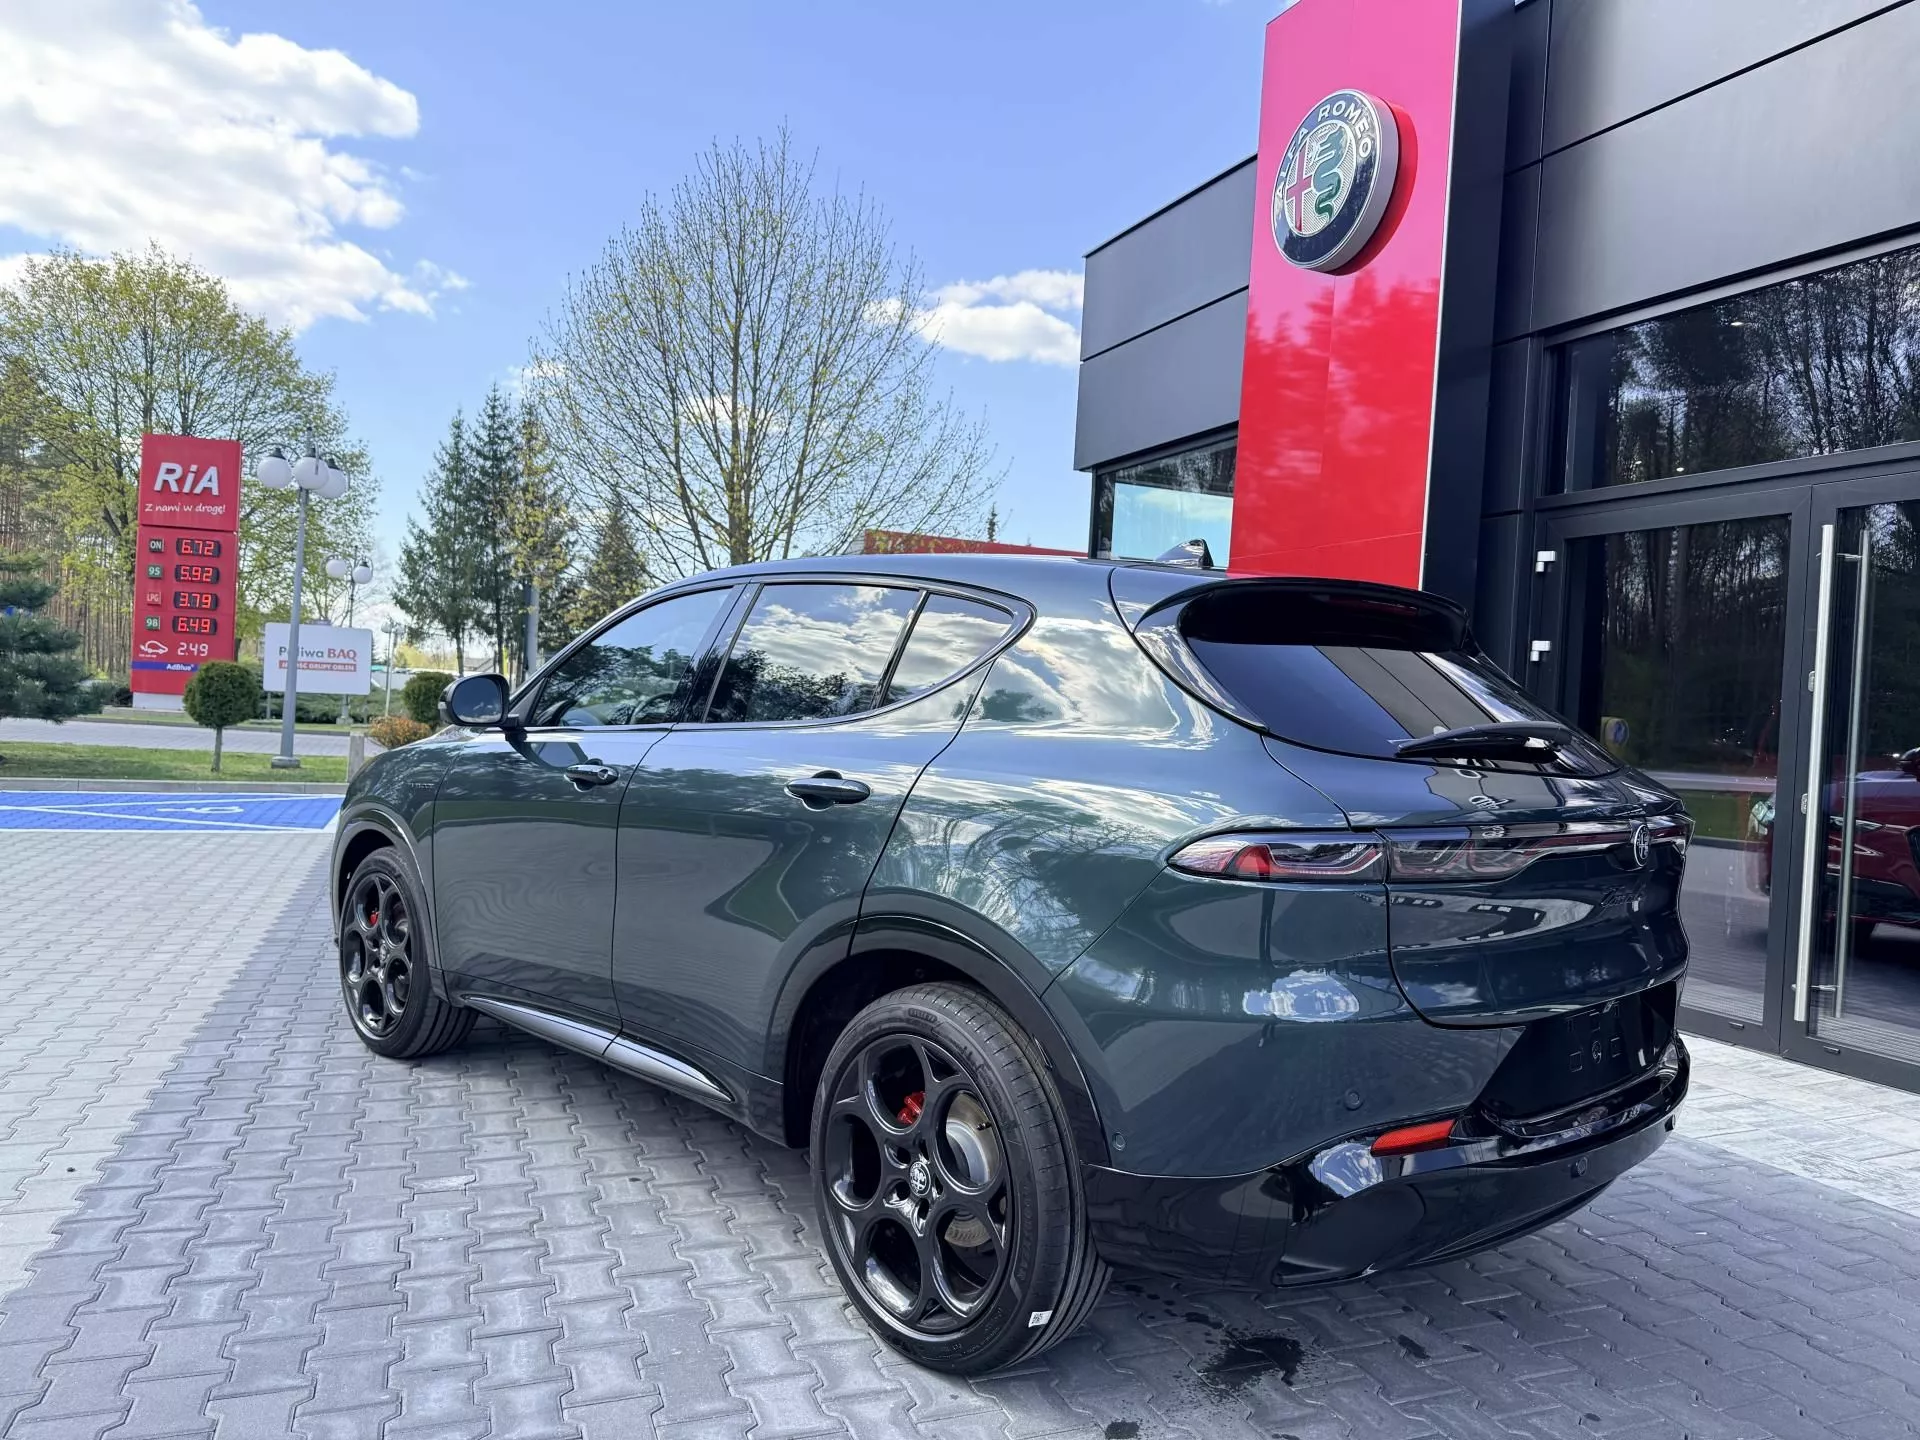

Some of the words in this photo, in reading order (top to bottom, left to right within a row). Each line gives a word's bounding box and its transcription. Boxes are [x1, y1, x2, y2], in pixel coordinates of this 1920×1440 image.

[1275, 126, 1310, 200] ALFA
[1317, 100, 1372, 159] ROMEO
[153, 461, 220, 497] RiA
[144, 503, 153, 512] Z
[155, 502, 180, 513] nami
[183, 504, 193, 512] w
[150, 540, 161, 549] ON
[181, 539, 214, 556] 6.72
[148, 566, 161, 576] 95
[180, 566, 213, 582] 5.92
[146, 593, 159, 602] LPG
[179, 592, 212, 609] 3.79
[146, 618, 158, 627] 98
[177, 617, 211, 633] 6.49
[177, 642, 209, 657] 2.49
[279, 646, 324, 658] Pliwa
[327, 647, 357, 662] BAQ
